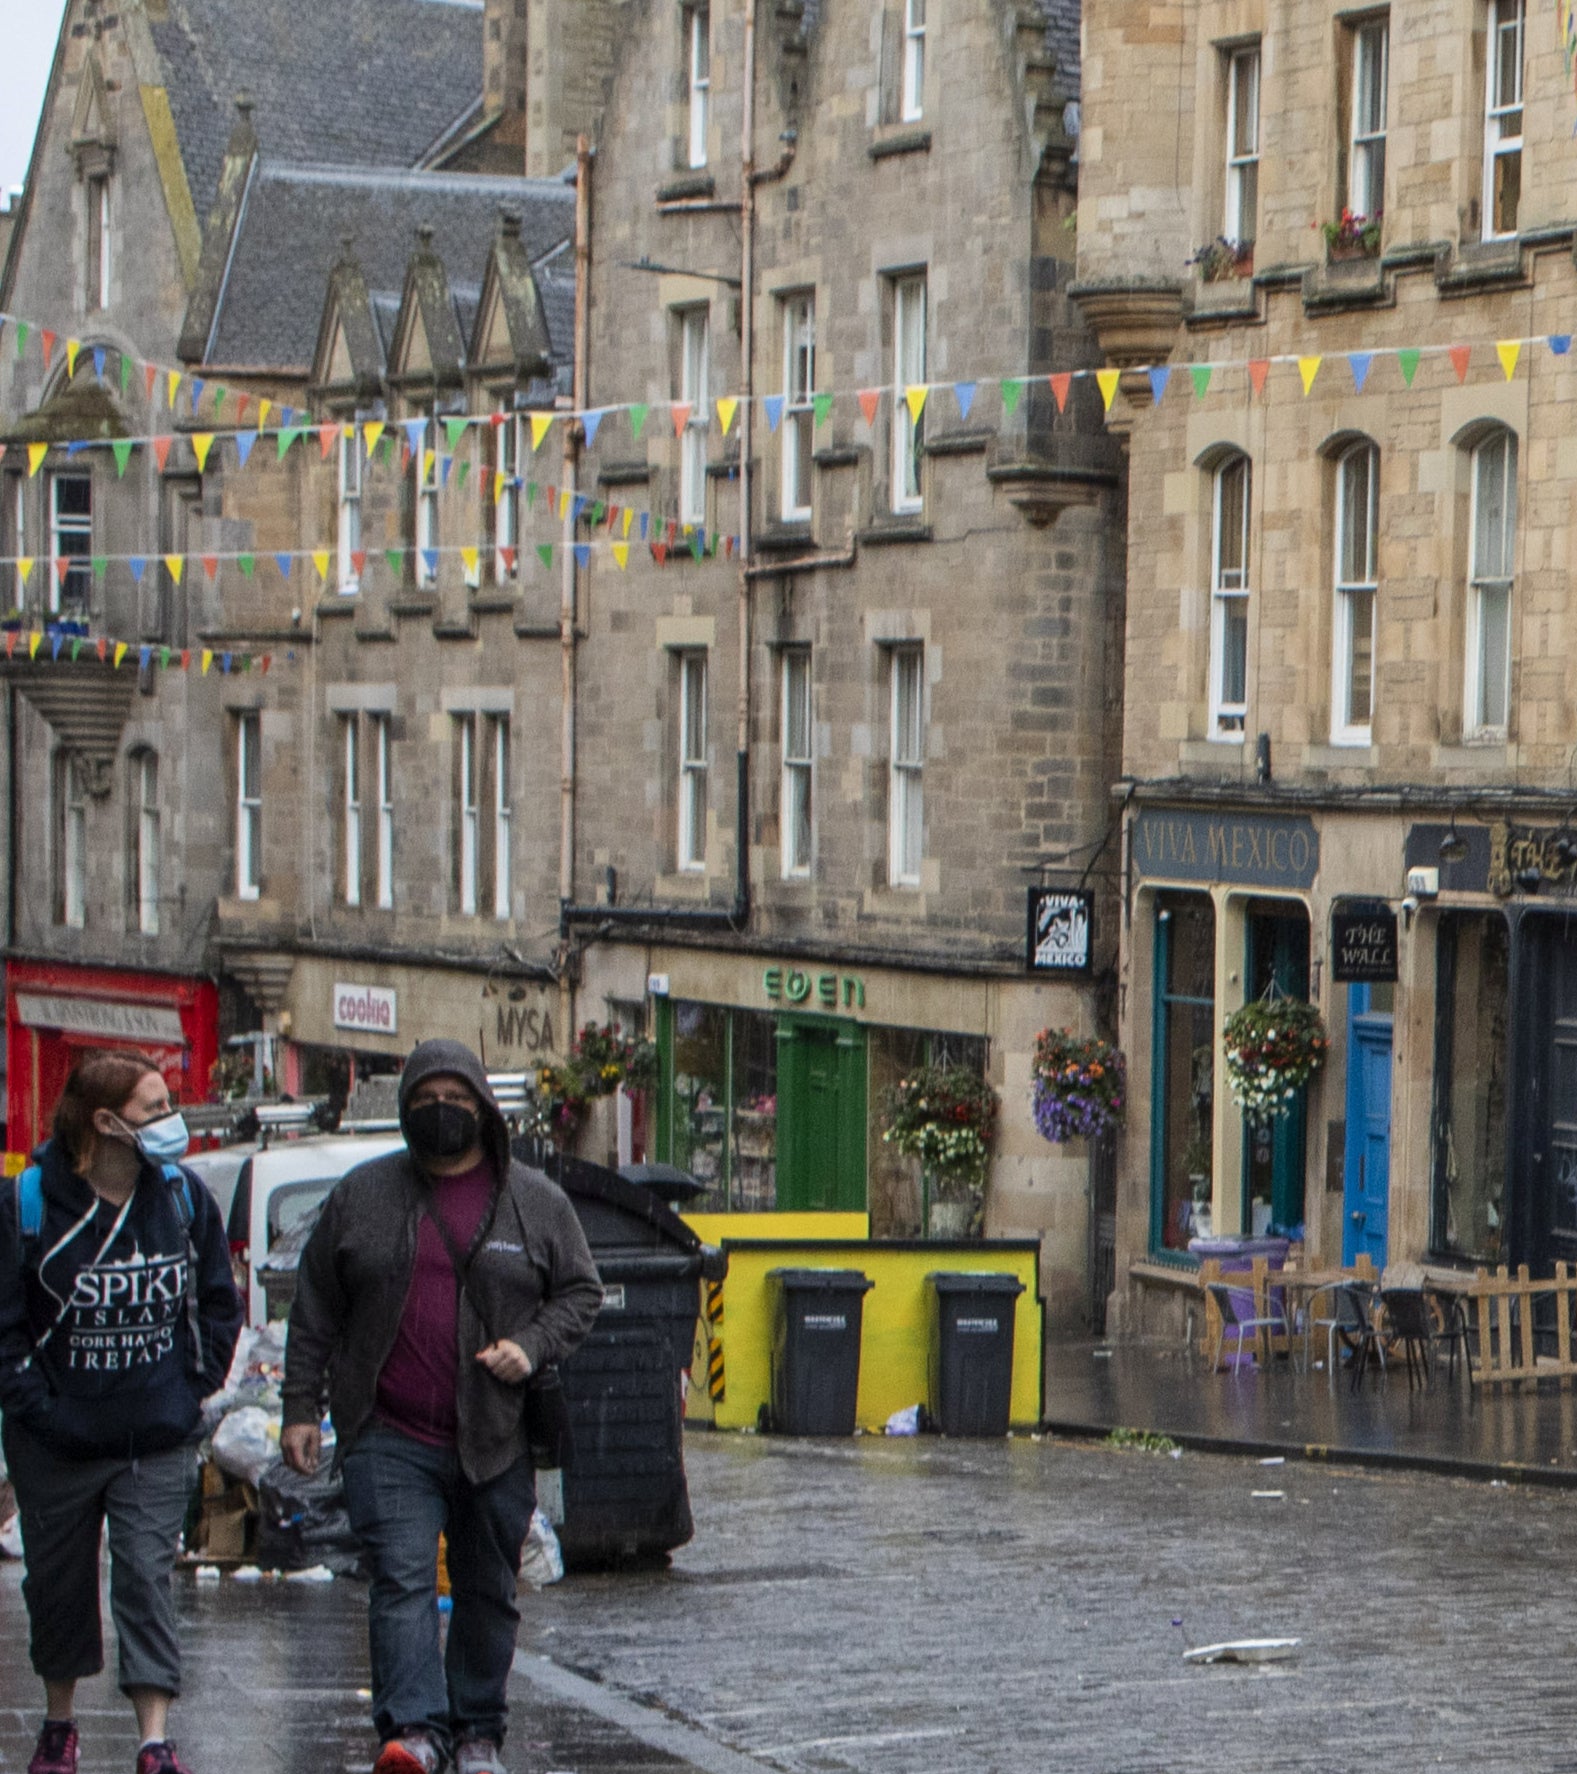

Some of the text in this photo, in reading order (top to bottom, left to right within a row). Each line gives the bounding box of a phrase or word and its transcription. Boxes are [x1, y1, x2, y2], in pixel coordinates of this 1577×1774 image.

[1142, 819, 1311, 874] VIVA MEXICO
[1044, 895, 1080, 909] VIVA
[1345, 922, 1389, 946] THE
[1034, 950, 1087, 968] MEXICO
[1341, 947, 1394, 967] WALL
[497, 1007, 554, 1050] MYSA
[70, 1335, 115, 1349] CORK
